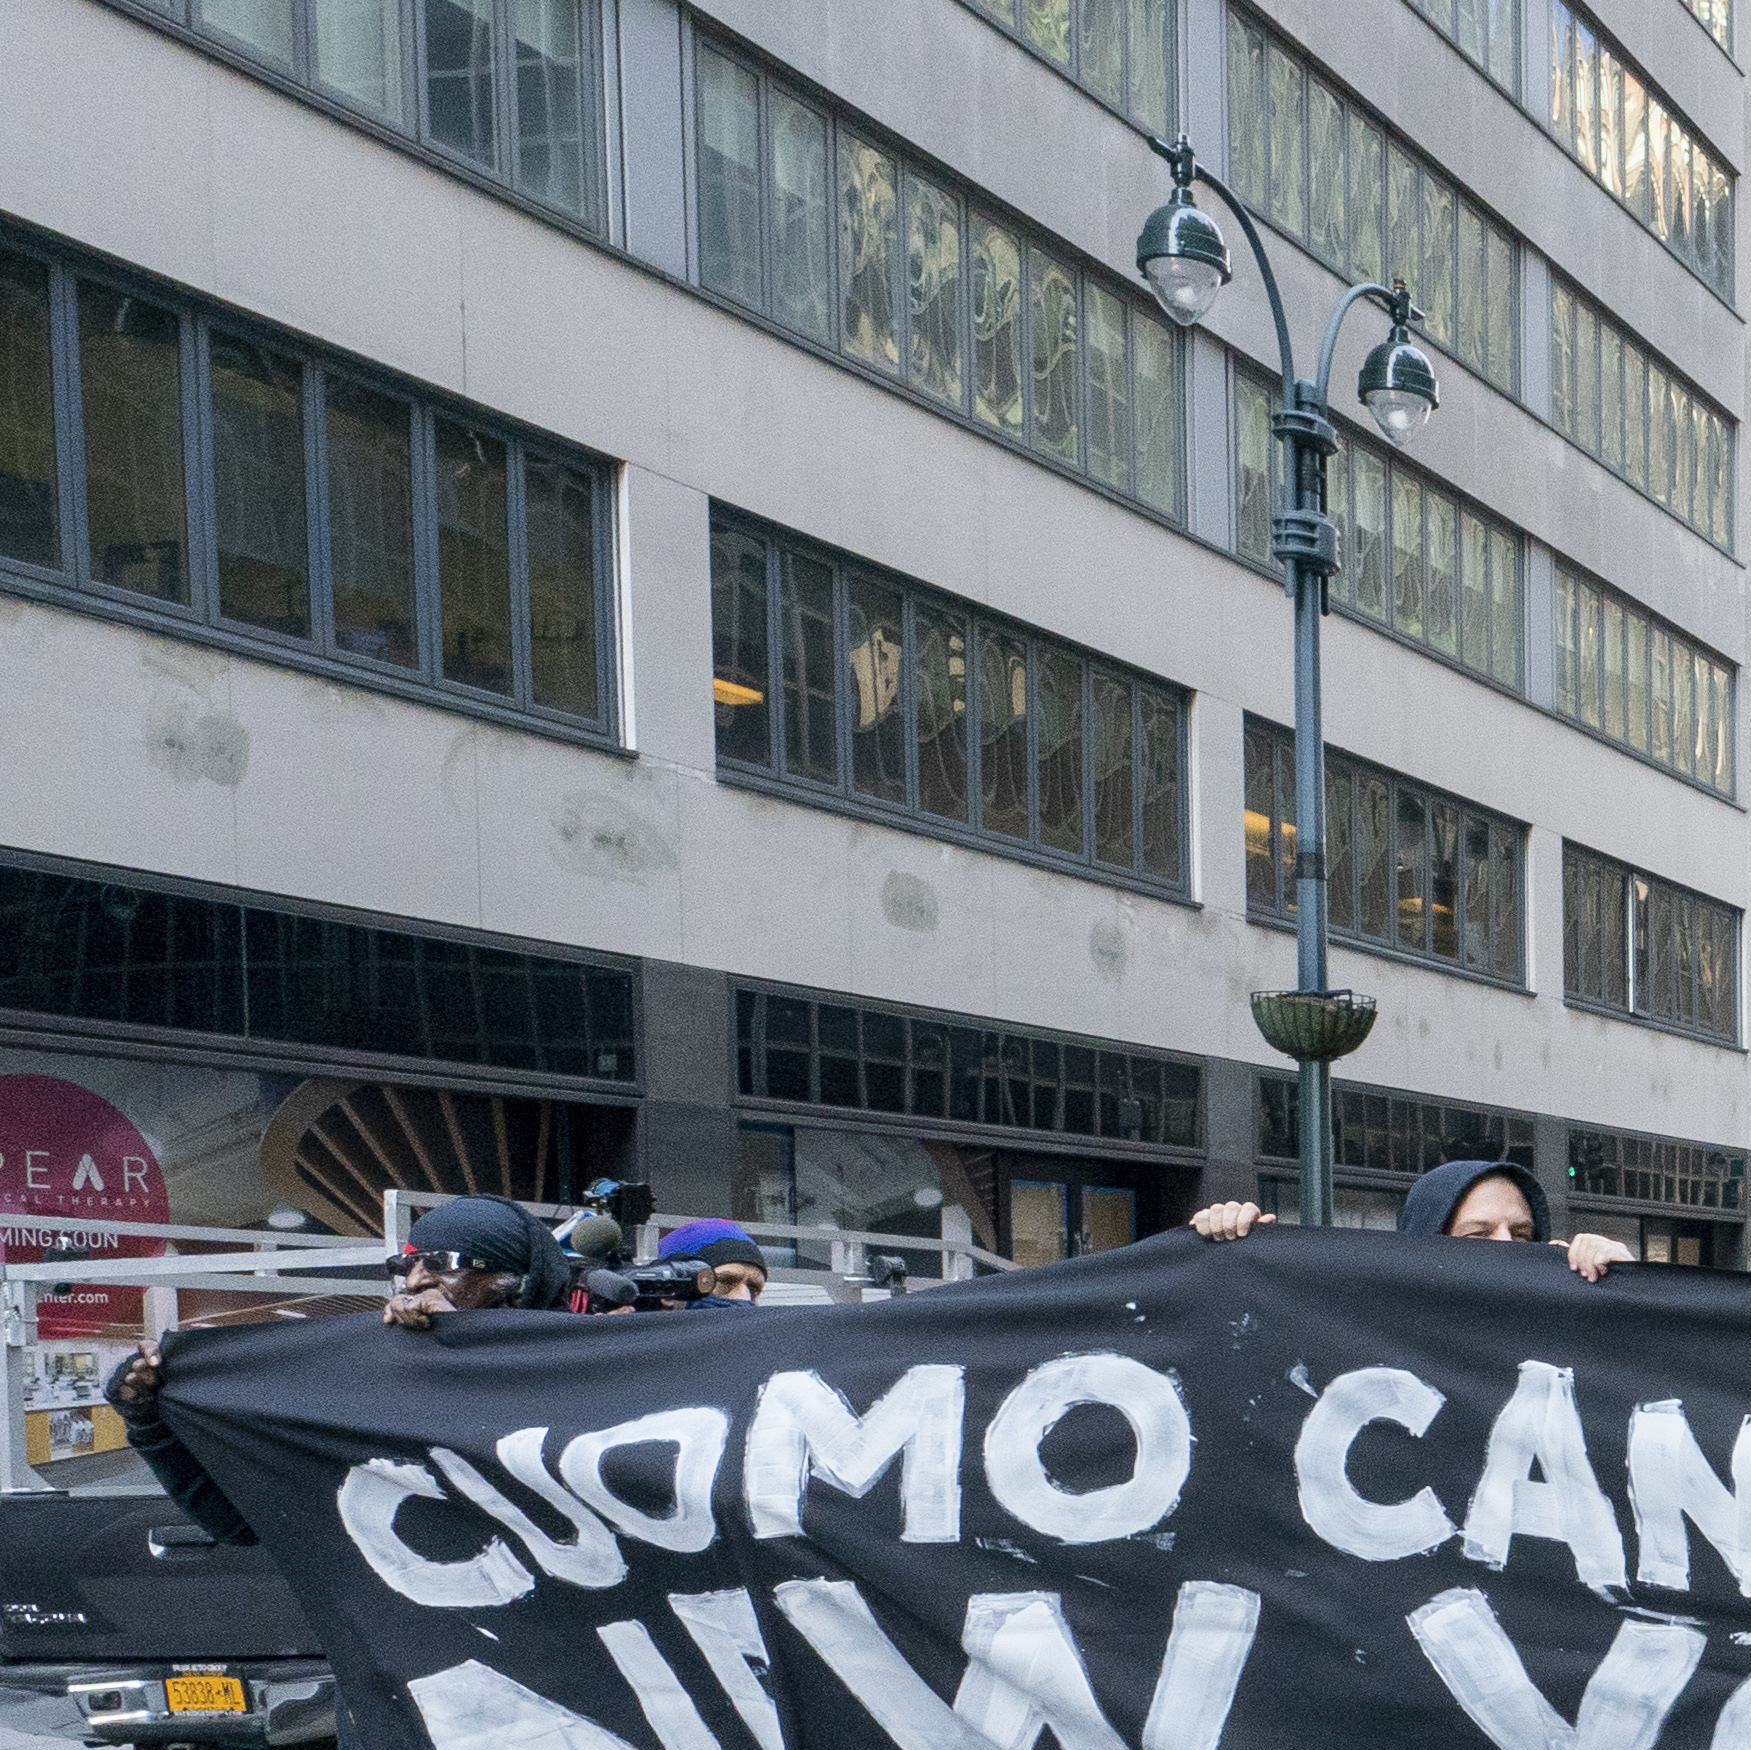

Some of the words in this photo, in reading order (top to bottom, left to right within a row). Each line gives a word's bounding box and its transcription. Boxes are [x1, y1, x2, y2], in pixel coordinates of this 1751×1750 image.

[0, 1150, 150, 1193] EAR
[58, 1195, 151, 1208] THERAPY
[336, 1350, 1193, 1608] CUOMO
